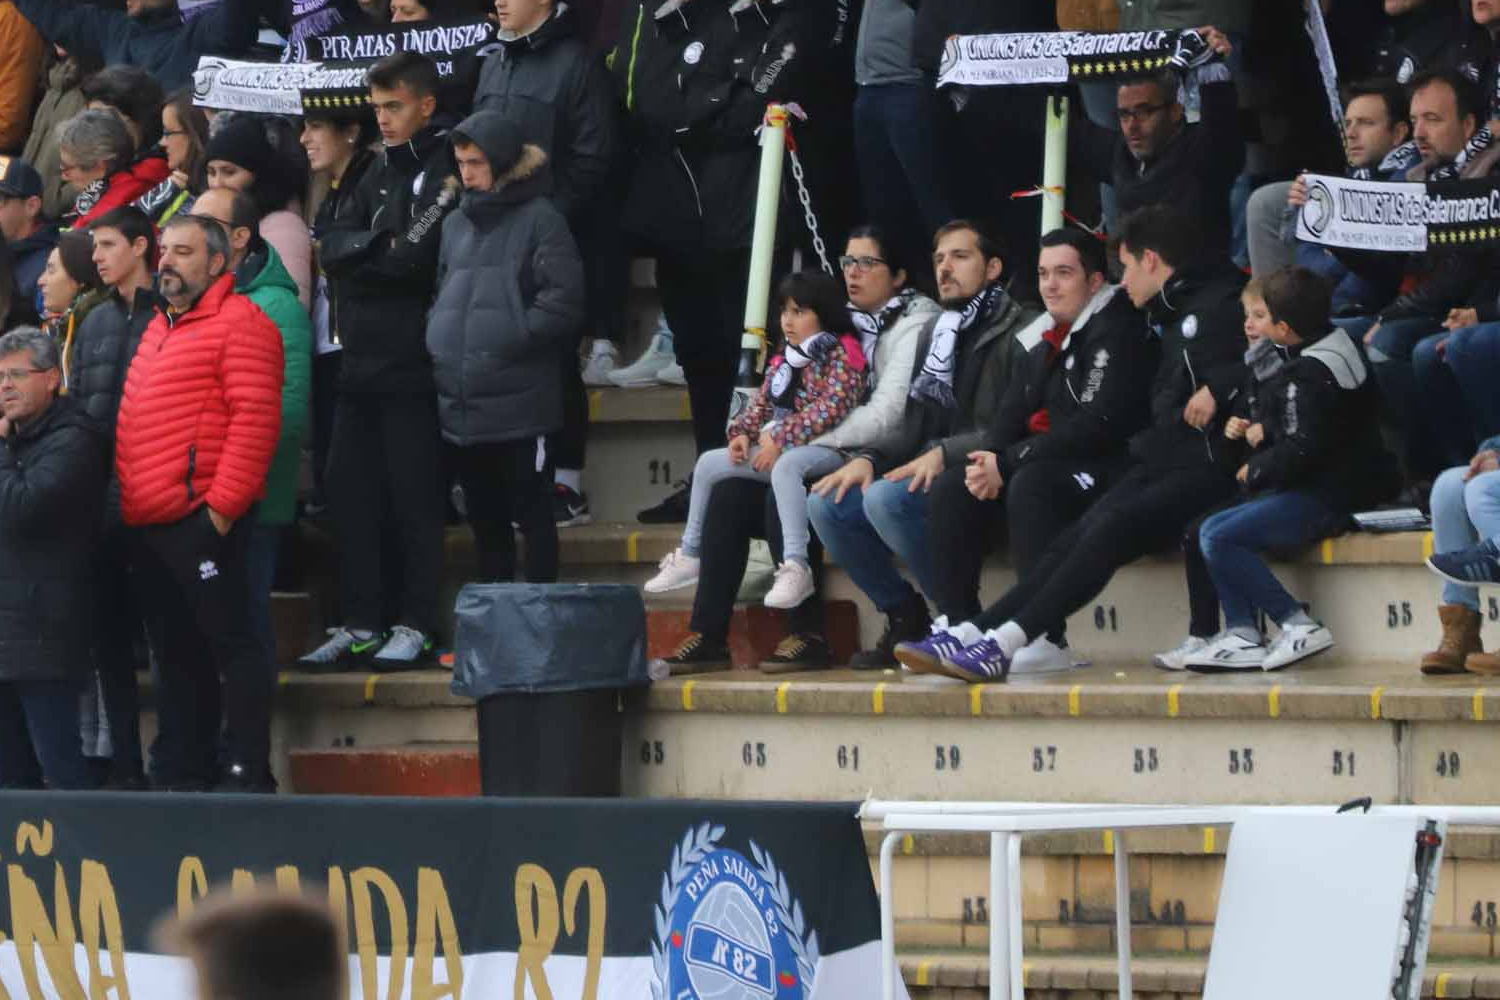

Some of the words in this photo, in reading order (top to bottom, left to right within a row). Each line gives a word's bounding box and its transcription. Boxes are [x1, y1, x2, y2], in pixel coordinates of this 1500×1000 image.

[318, 33, 396, 61] PIRATAS
[1061, 32, 1141, 56] Salamanca
[1339, 187, 1405, 224] UNIONISTAS
[1422, 195, 1489, 224] Salamanca
[837, 745, 860, 771] 61
[1033, 746, 1057, 773] 57
[1332, 749, 1356, 776] 51
[1436, 751, 1460, 777] 49
[686, 858, 720, 901] PEÑA
[723, 856, 765, 905] SALIDA
[765, 908, 779, 937] 82
[733, 948, 757, 981] 82
